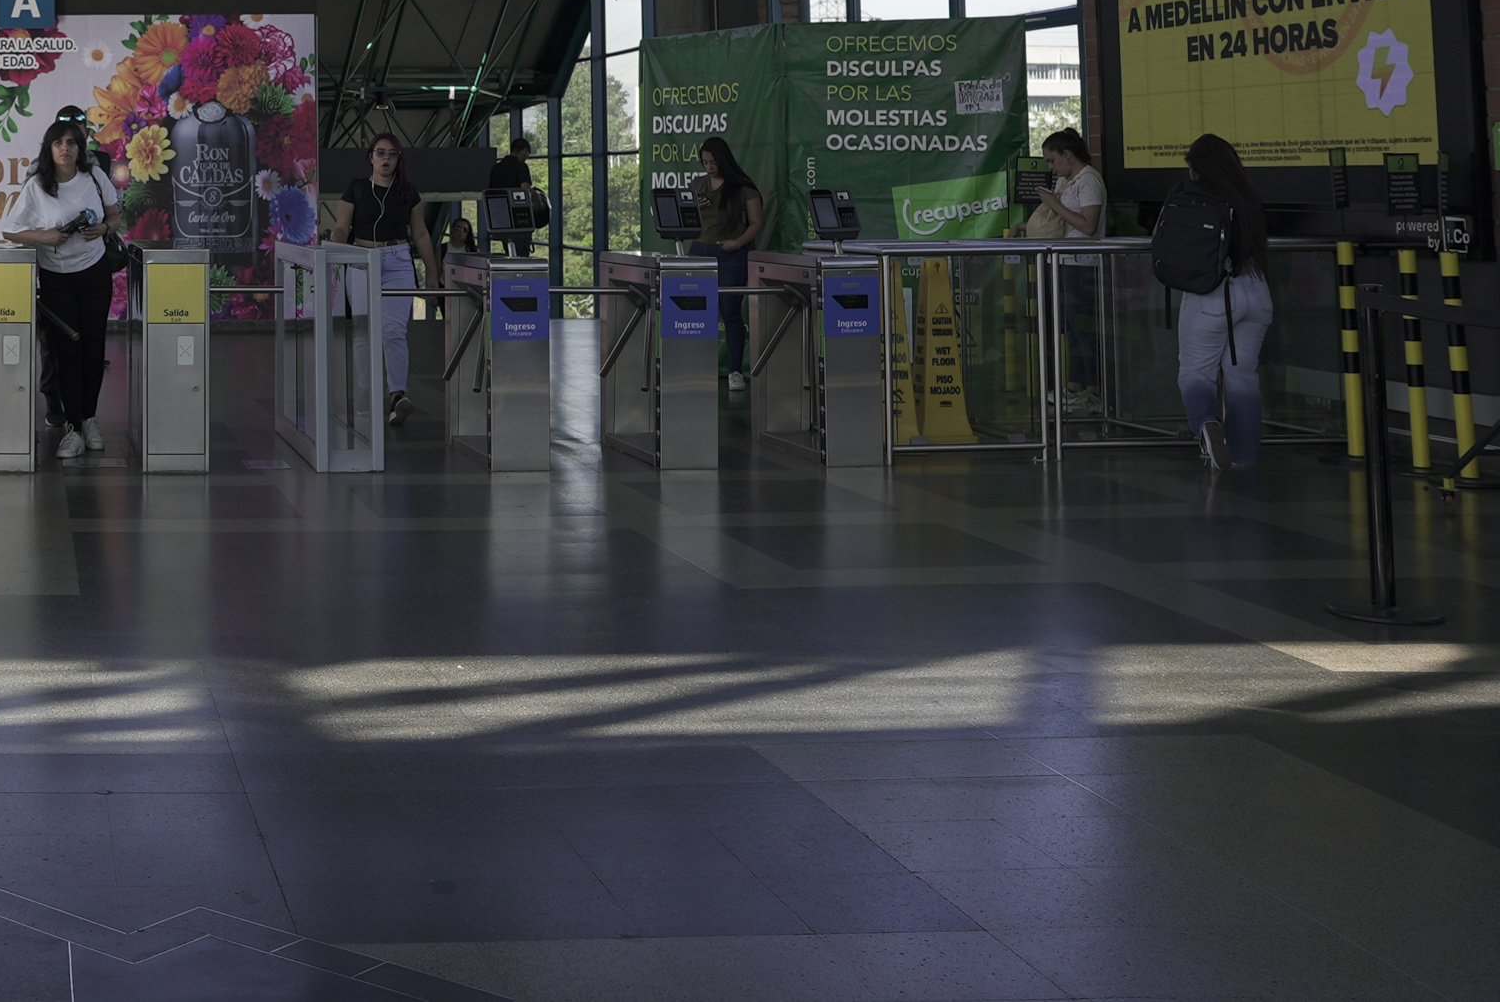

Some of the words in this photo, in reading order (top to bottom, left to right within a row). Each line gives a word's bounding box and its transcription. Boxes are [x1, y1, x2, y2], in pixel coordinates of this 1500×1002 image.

[1128, 8, 1142, 33] A
[18, 40, 32, 50] LA
[35, 40, 77, 50] SALUD.
[827, 35, 957, 52] OFRECEMOS
[1187, 34, 1214, 62] EN
[1220, 30, 1247, 59] 24
[1253, 19, 1338, 55] HORAS
[3, 57, 37, 67] EDAD.
[827, 60, 942, 76] DISCULPAS
[653, 83, 739, 106] OFRECEMOS
[827, 85, 868, 101] POR
[876, 85, 912, 101] LAS
[653, 112, 727, 134] DISCULPAS
[827, 109, 947, 126] MOLESTIAS
[826, 134, 988, 151] OCASIONADAS
[195, 144, 229, 161] RON
[652, 143, 679, 162] POR
[682, 143, 703, 162] LA
[192, 161, 218, 170] VIEJO
[220, 162, 230, 170] DE
[179, 166, 244, 185] CALDAS
[209, 191, 216, 202] 8
[210, 211, 220, 222] de
[221, 211, 236, 223] Oro
[1396, 220, 1439, 234] powered
[1428, 235, 1440, 252] by
[505, 323, 536, 331] Ingreso
[674, 321, 705, 330] Ingreso
[837, 320, 867, 328] Ingreso
[935, 347, 951, 355] WET
[932, 358, 955, 366] FLOOR
[937, 375, 953, 384] PISO
[930, 386, 960, 395] MOJADO
